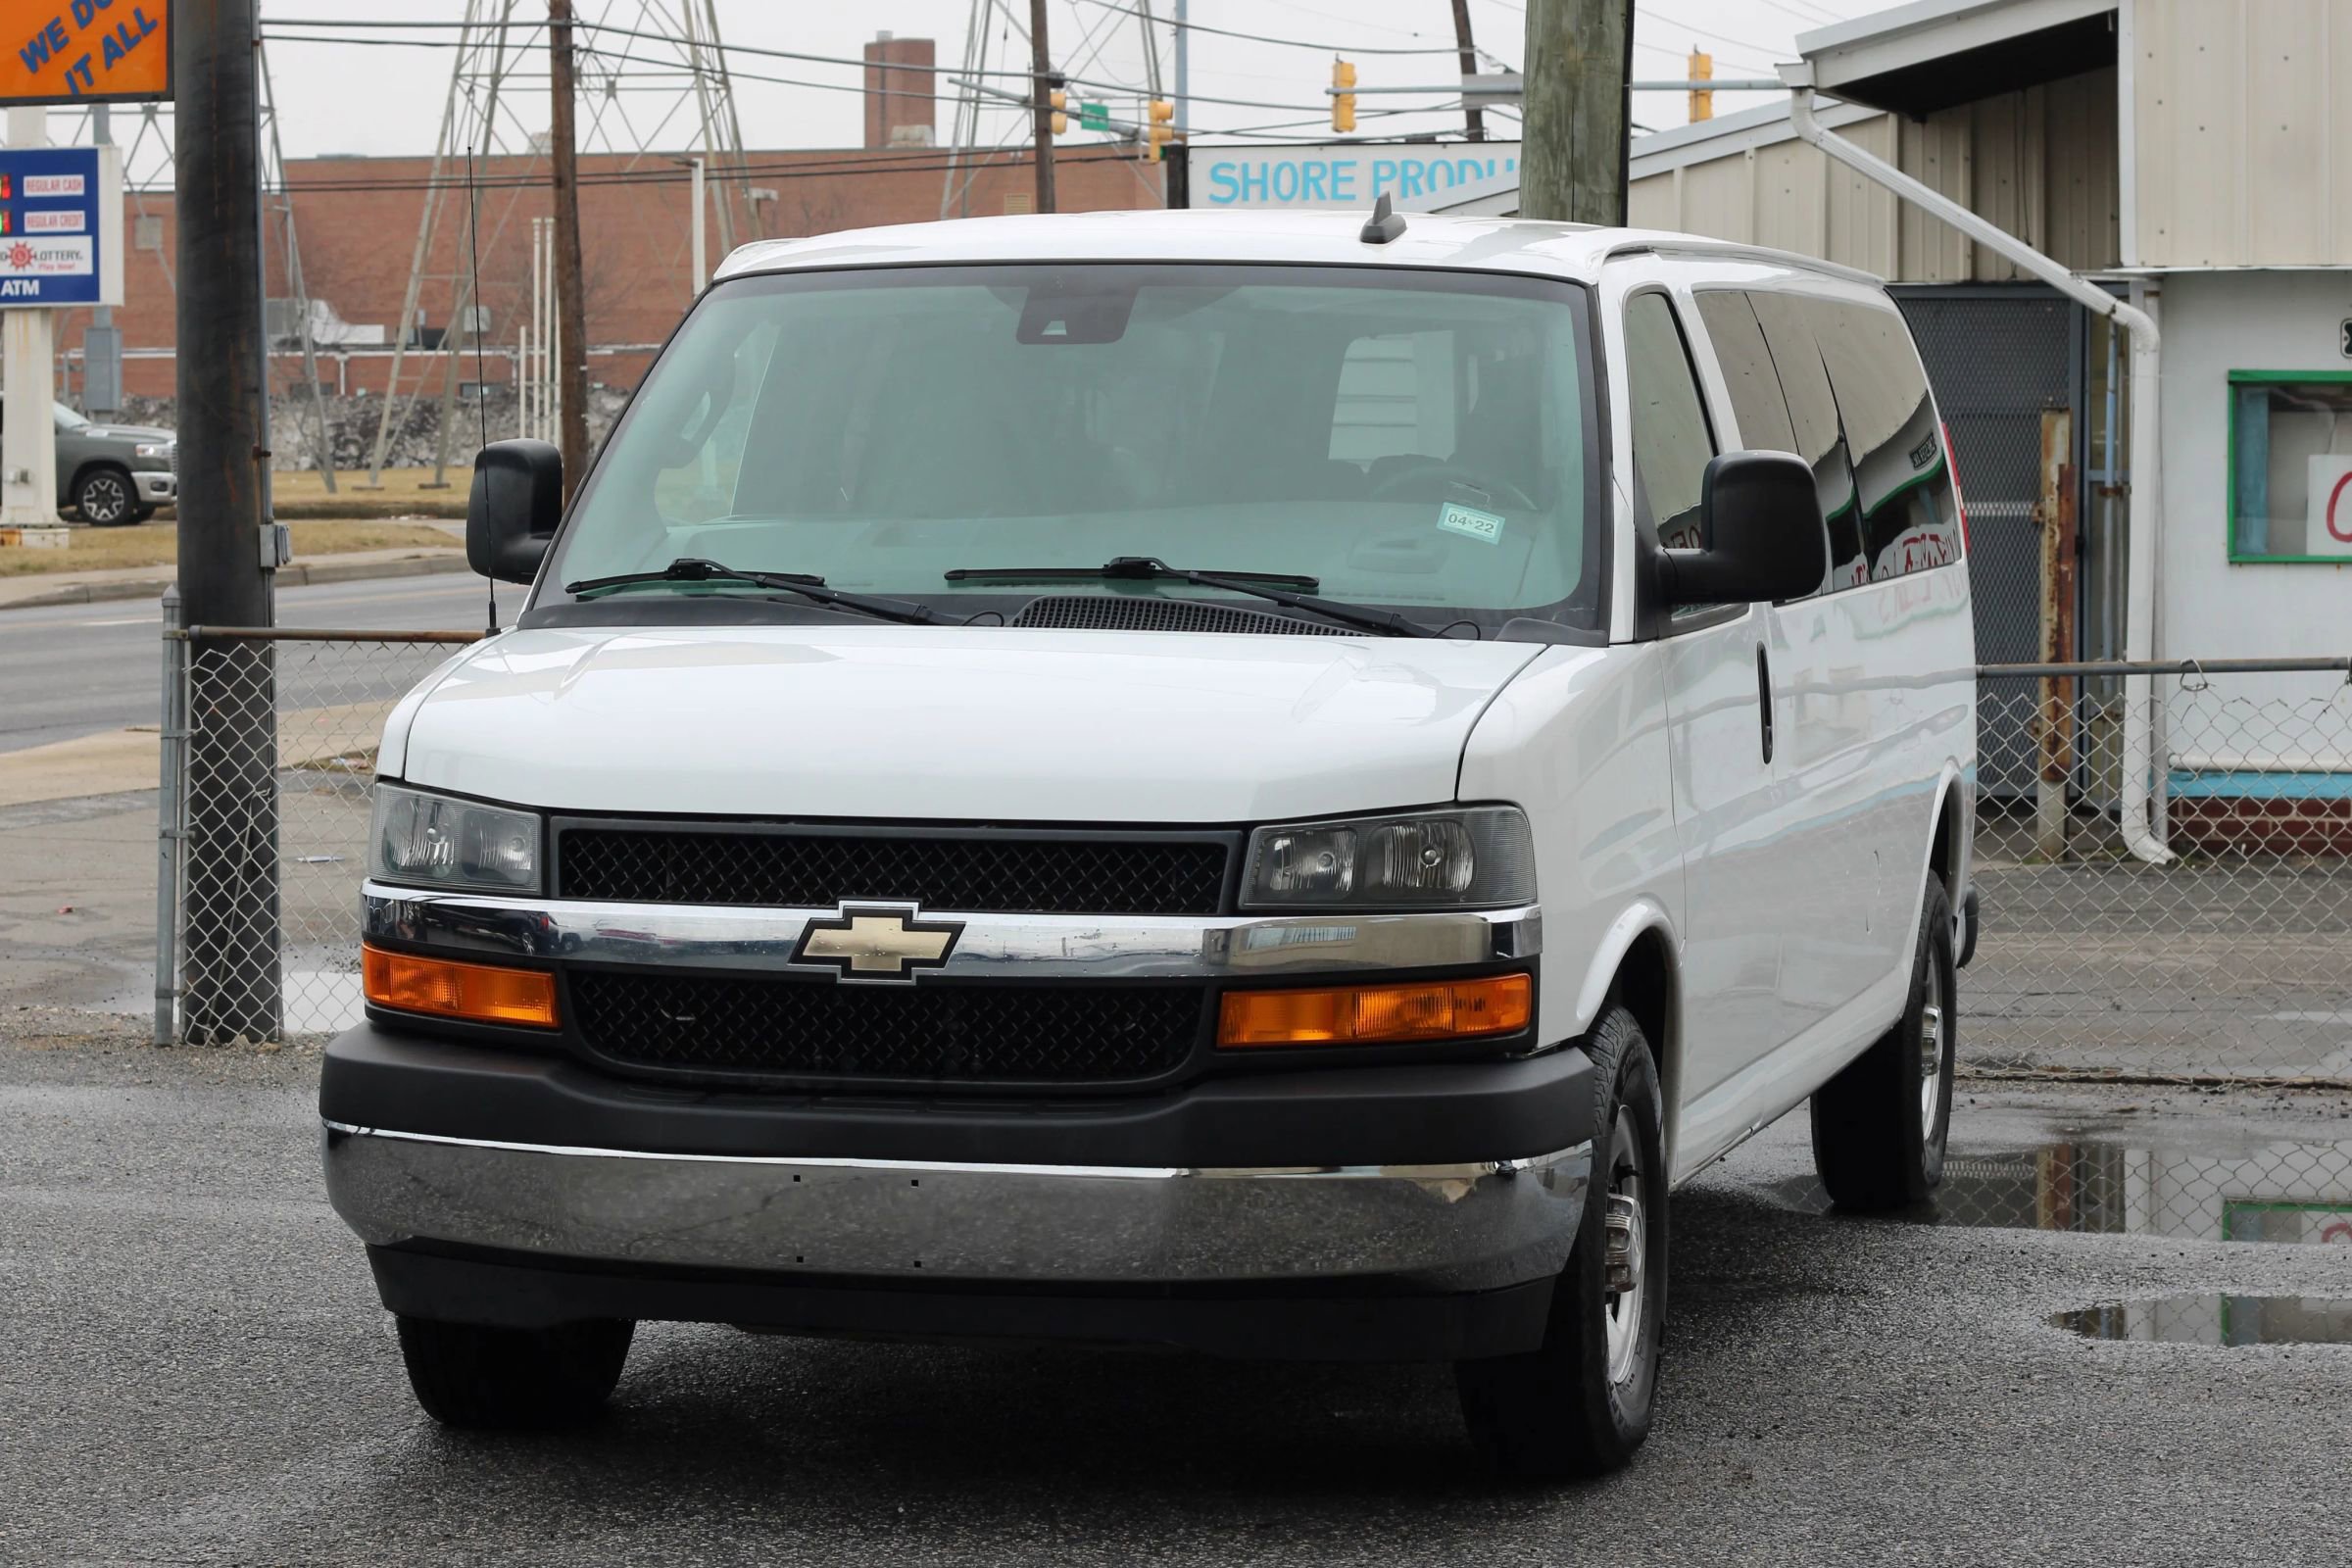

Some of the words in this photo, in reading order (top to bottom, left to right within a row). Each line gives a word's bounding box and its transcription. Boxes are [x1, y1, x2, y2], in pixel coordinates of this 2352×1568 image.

[19, 16, 70, 74] WE
[64, 52, 94, 95] IT
[102, 7, 158, 71] ALL
[26, 179, 61, 192] REGULAR
[1208, 160, 1356, 204] SHORE
[27, 214, 59, 228] REGULAR
[1, 279, 40, 296] ATM
